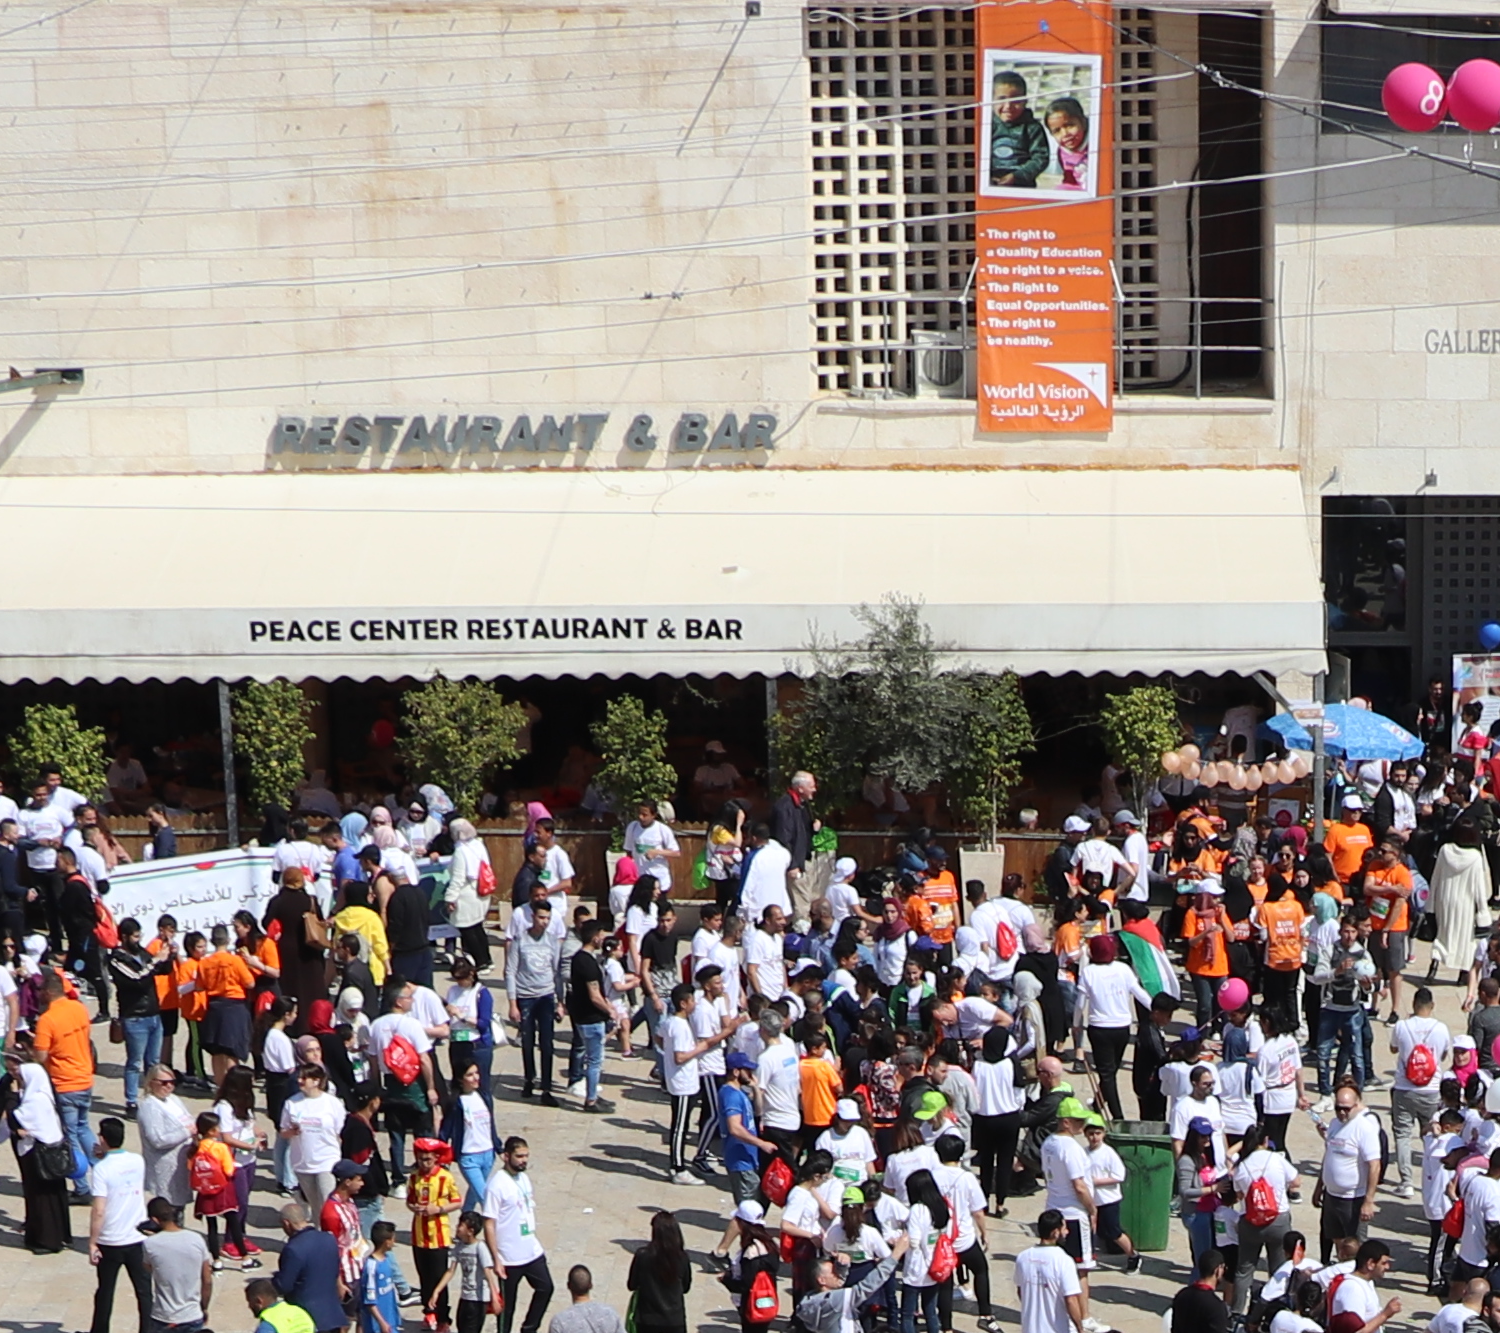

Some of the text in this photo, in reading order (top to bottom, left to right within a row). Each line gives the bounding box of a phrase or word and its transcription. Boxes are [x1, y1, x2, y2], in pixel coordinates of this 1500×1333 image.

[987, 229, 1056, 242] The right to
[986, 247, 1102, 259] a Quality Education
[987, 264, 1103, 278] The right to a voice.
[987, 282, 1059, 295] The Right to
[986, 300, 1109, 313] Equal Opportunities.
[988, 318, 1056, 330] The right to
[987, 335, 1053, 347] be healthy.
[983, 383, 1089, 399] World Vision
[991, 405, 1084, 421] الرؤية العالمية
[273, 412, 779, 455] RESTAURANT & BAR
[249, 617, 743, 642] PEACE CENTER RESTAURANT & BAR
